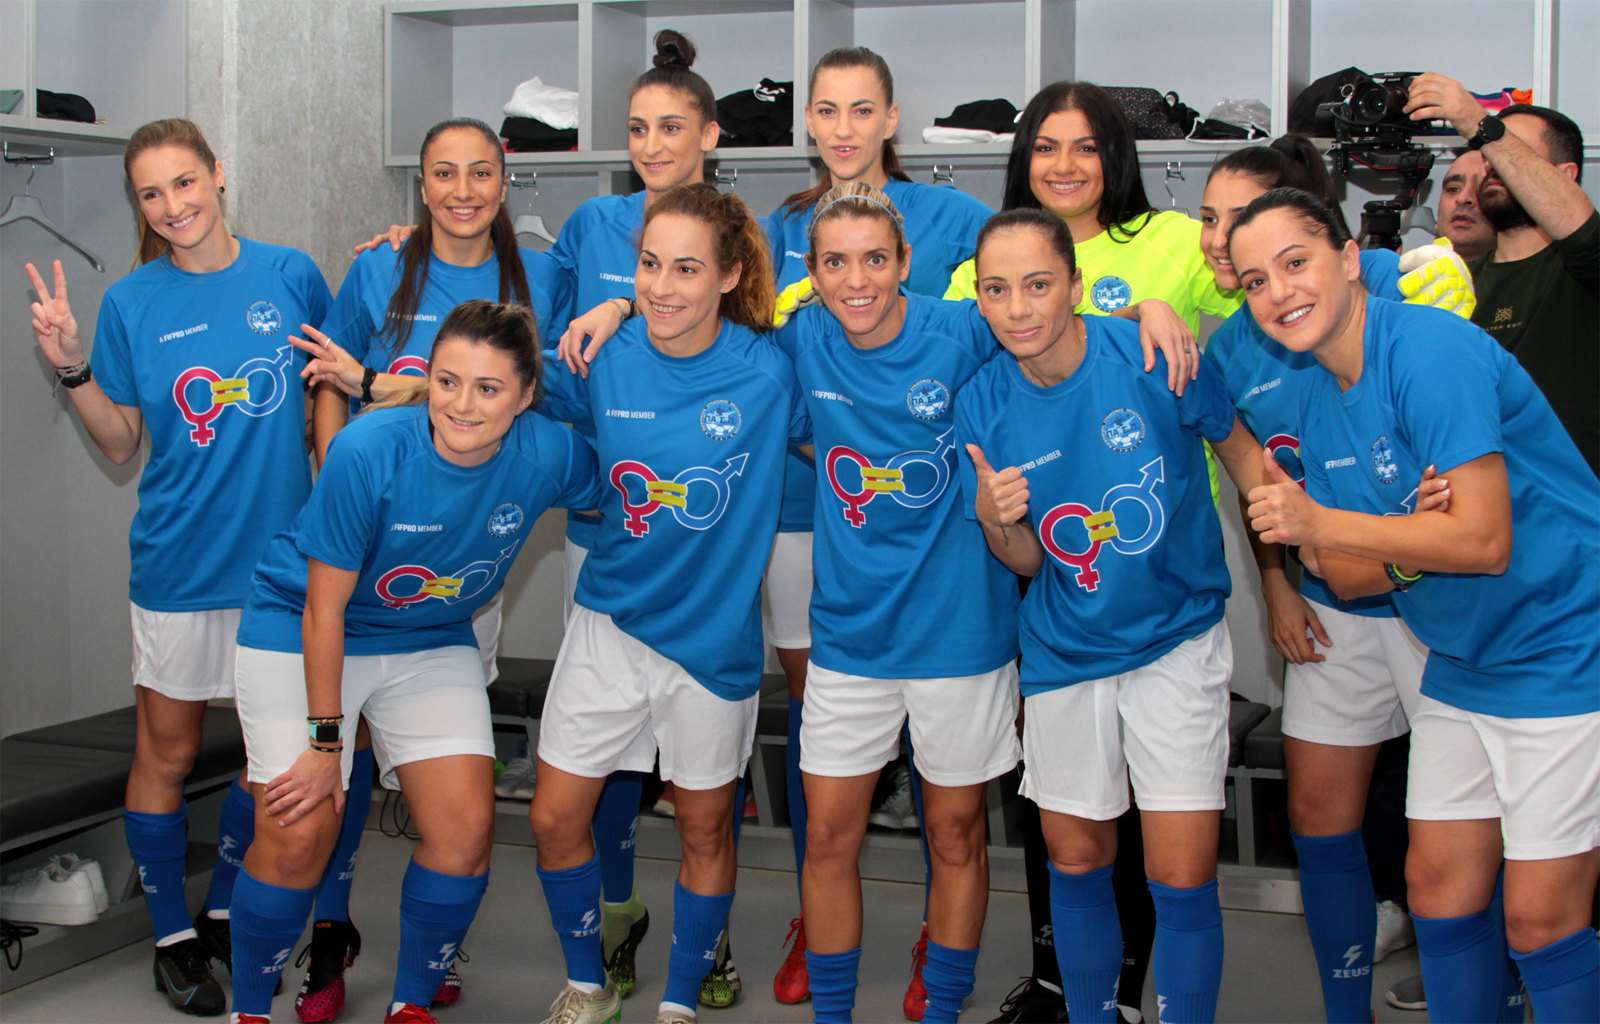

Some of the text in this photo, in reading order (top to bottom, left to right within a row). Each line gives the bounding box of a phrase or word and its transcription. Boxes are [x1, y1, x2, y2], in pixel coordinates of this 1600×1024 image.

[611, 409, 630, 418] FIFPRO
[631, 411, 656, 420] MEMBER
[1035, 449, 1062, 466] MEMBER
[417, 524, 443, 532] MEMBER
[1332, 965, 1370, 979] ZEUS
